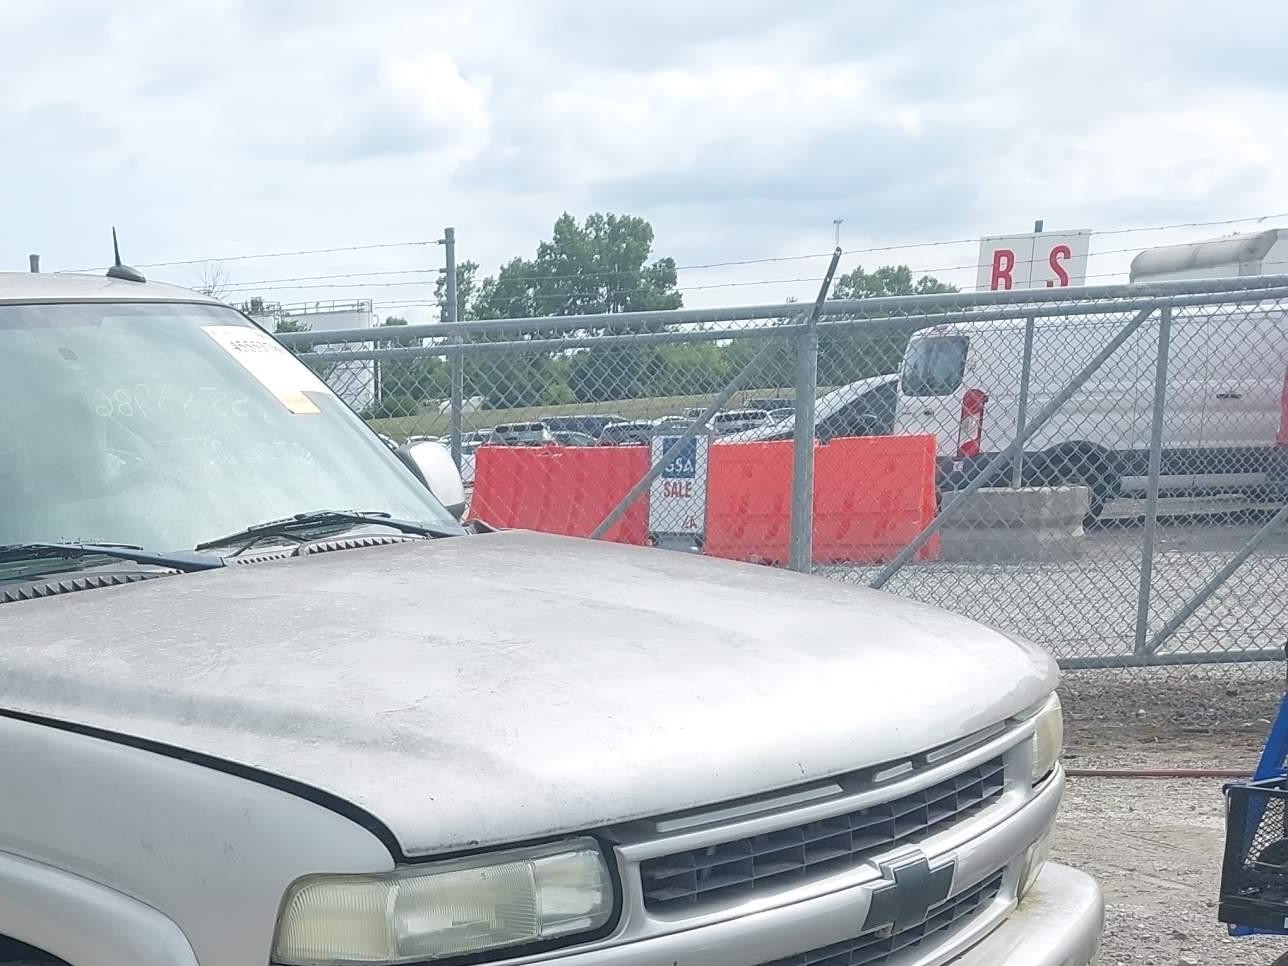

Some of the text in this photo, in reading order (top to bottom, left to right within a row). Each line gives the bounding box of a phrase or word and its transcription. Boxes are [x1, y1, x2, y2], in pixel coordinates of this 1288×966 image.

[991, 245, 1071, 291] R S
[663, 481, 692, 498] SALE
